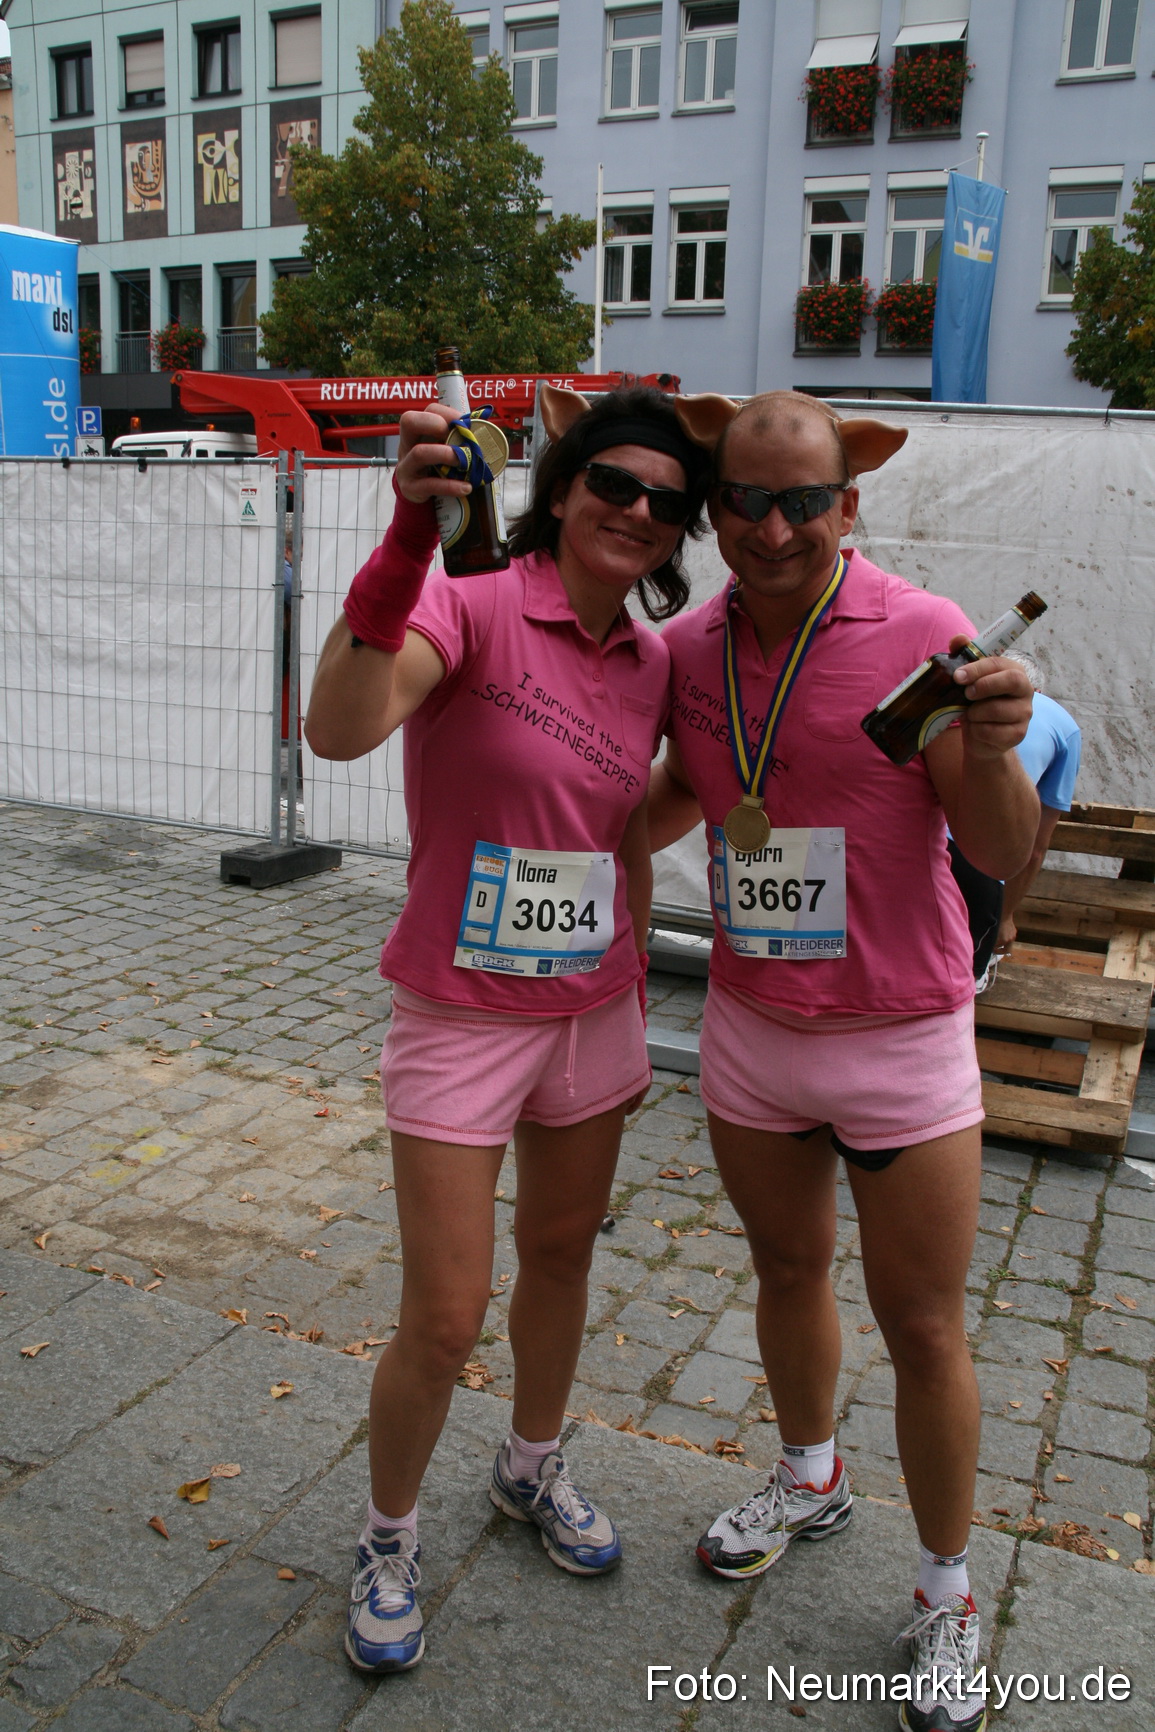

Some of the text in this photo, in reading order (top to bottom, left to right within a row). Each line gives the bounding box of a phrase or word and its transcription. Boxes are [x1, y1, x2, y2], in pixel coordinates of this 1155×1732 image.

[12, 270, 63, 306] maxi
[53, 307, 74, 334] dsl
[517, 672, 623, 758] I survived the
[748, 715, 766, 733] th
[516, 859, 558, 884] Ilona
[476, 890, 487, 908] D
[737, 877, 826, 913] 3667
[512, 898, 599, 933] 3034
[784, 939, 844, 951] PFLEIDERER
